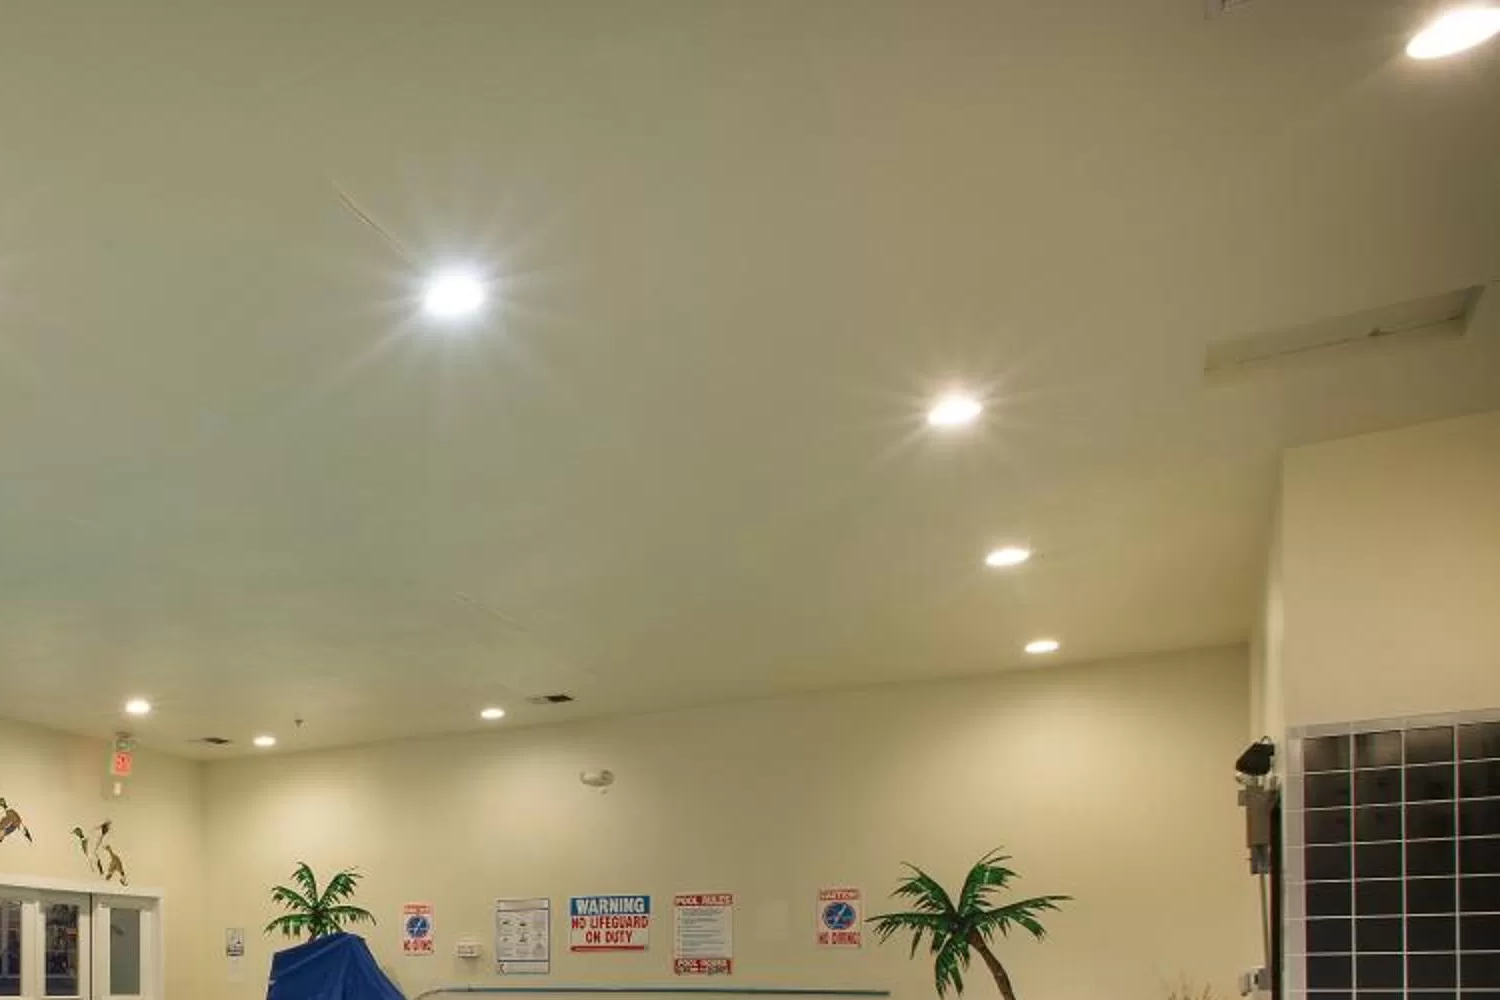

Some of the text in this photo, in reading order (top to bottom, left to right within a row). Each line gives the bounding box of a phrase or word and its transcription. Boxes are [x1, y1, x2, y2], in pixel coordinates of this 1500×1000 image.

[576, 898, 645, 914] WARNING
[571, 915, 649, 929] NO LIFEGUARD
[585, 930, 633, 944] ON DUTY
